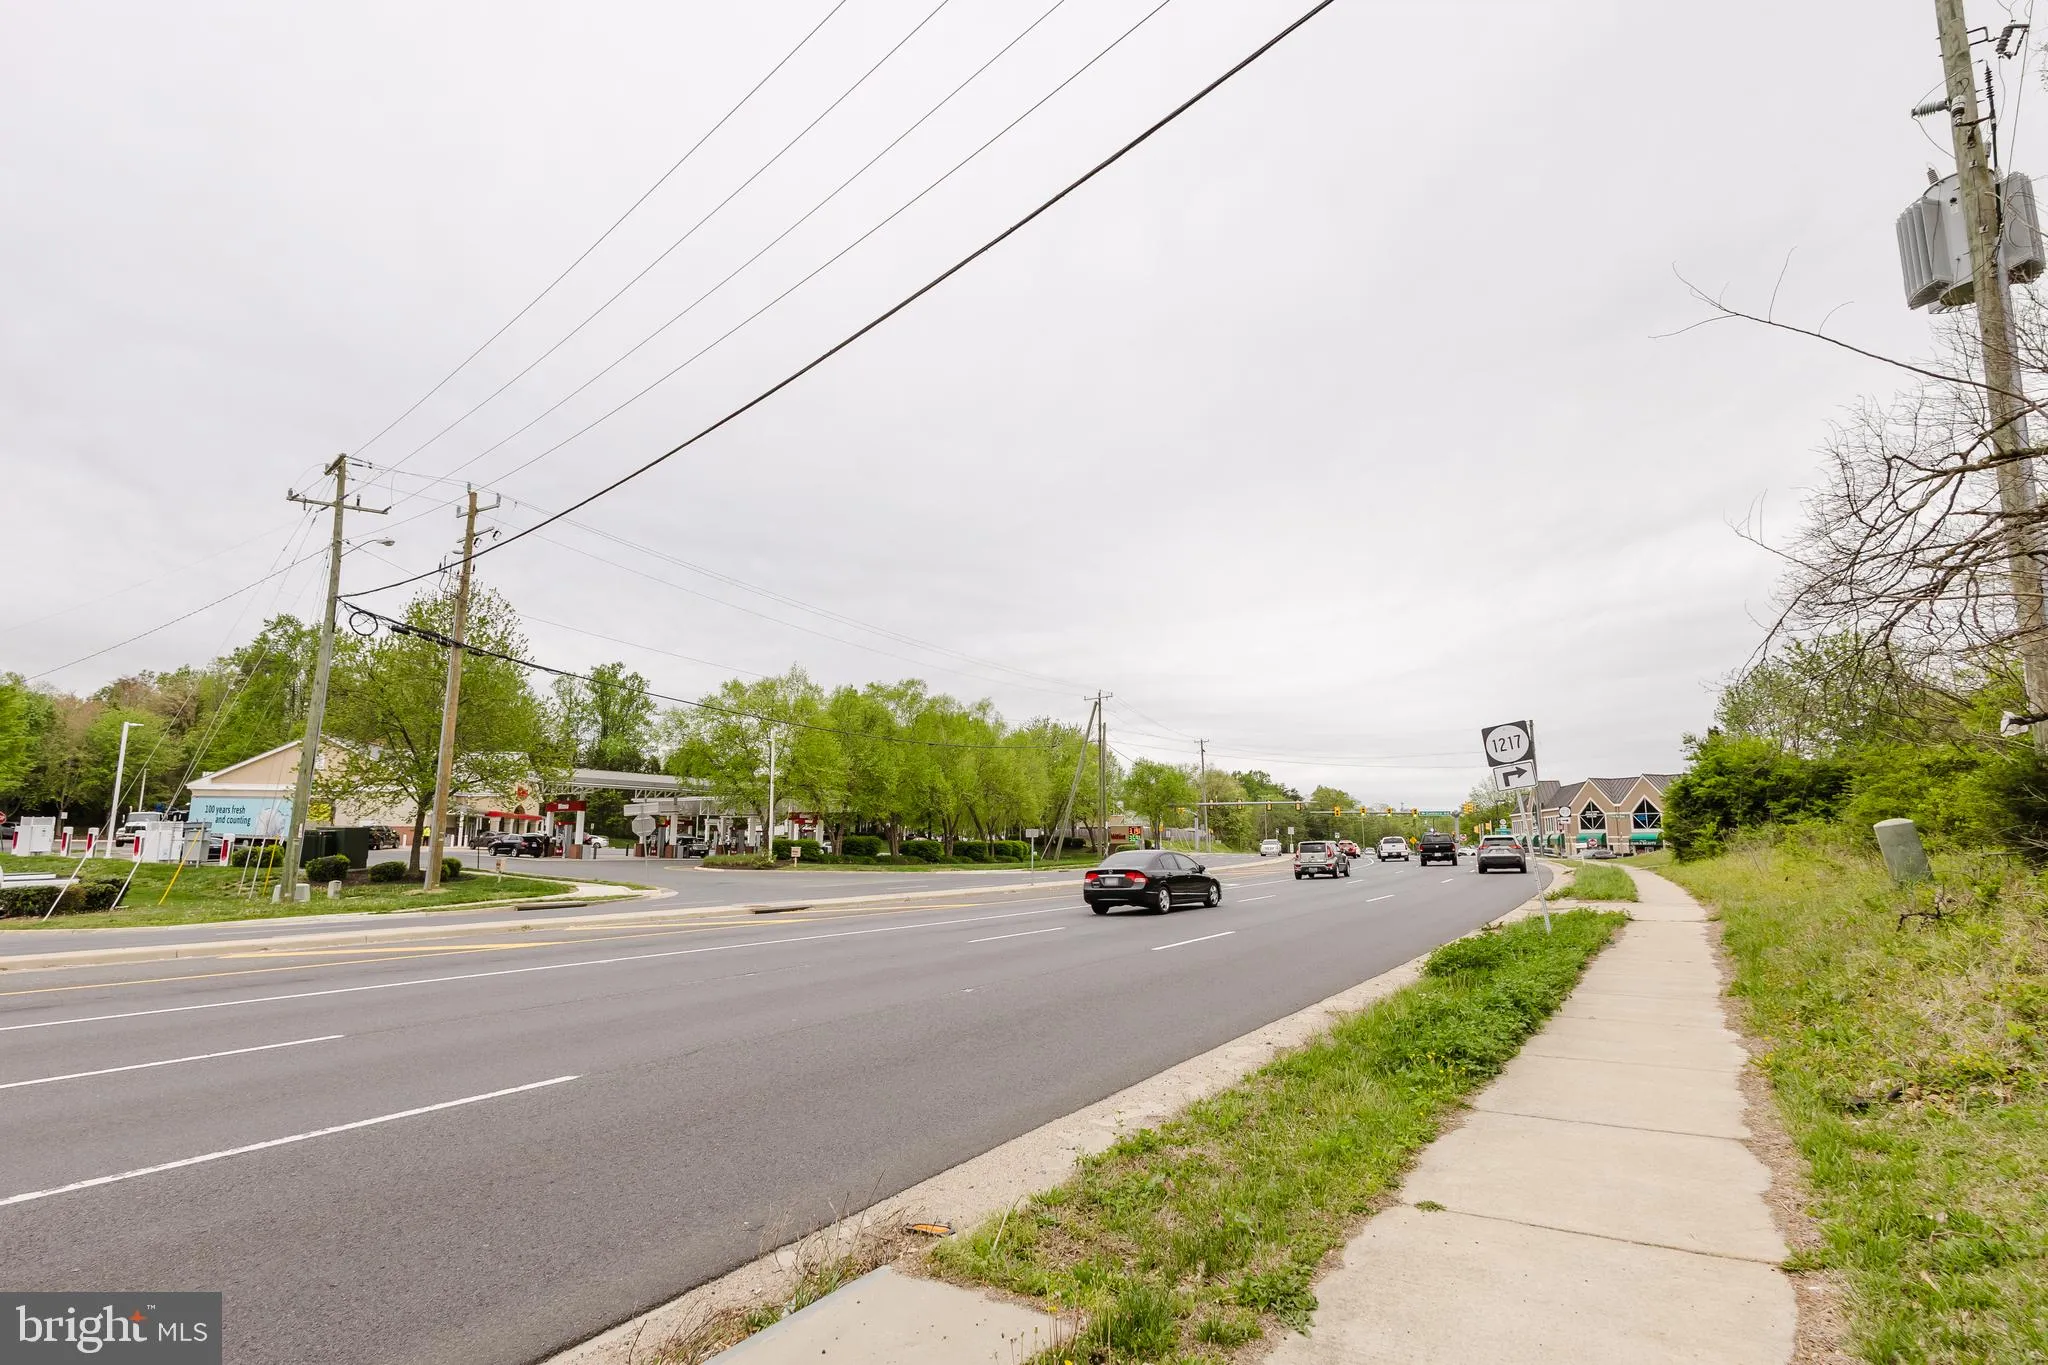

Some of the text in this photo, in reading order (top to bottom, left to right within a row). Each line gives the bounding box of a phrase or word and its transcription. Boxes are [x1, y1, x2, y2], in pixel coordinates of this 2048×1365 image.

[1492, 735, 1521, 753] 1217
[204, 804, 246, 815] 100 years fresh
[215, 816, 251, 826] and counting
